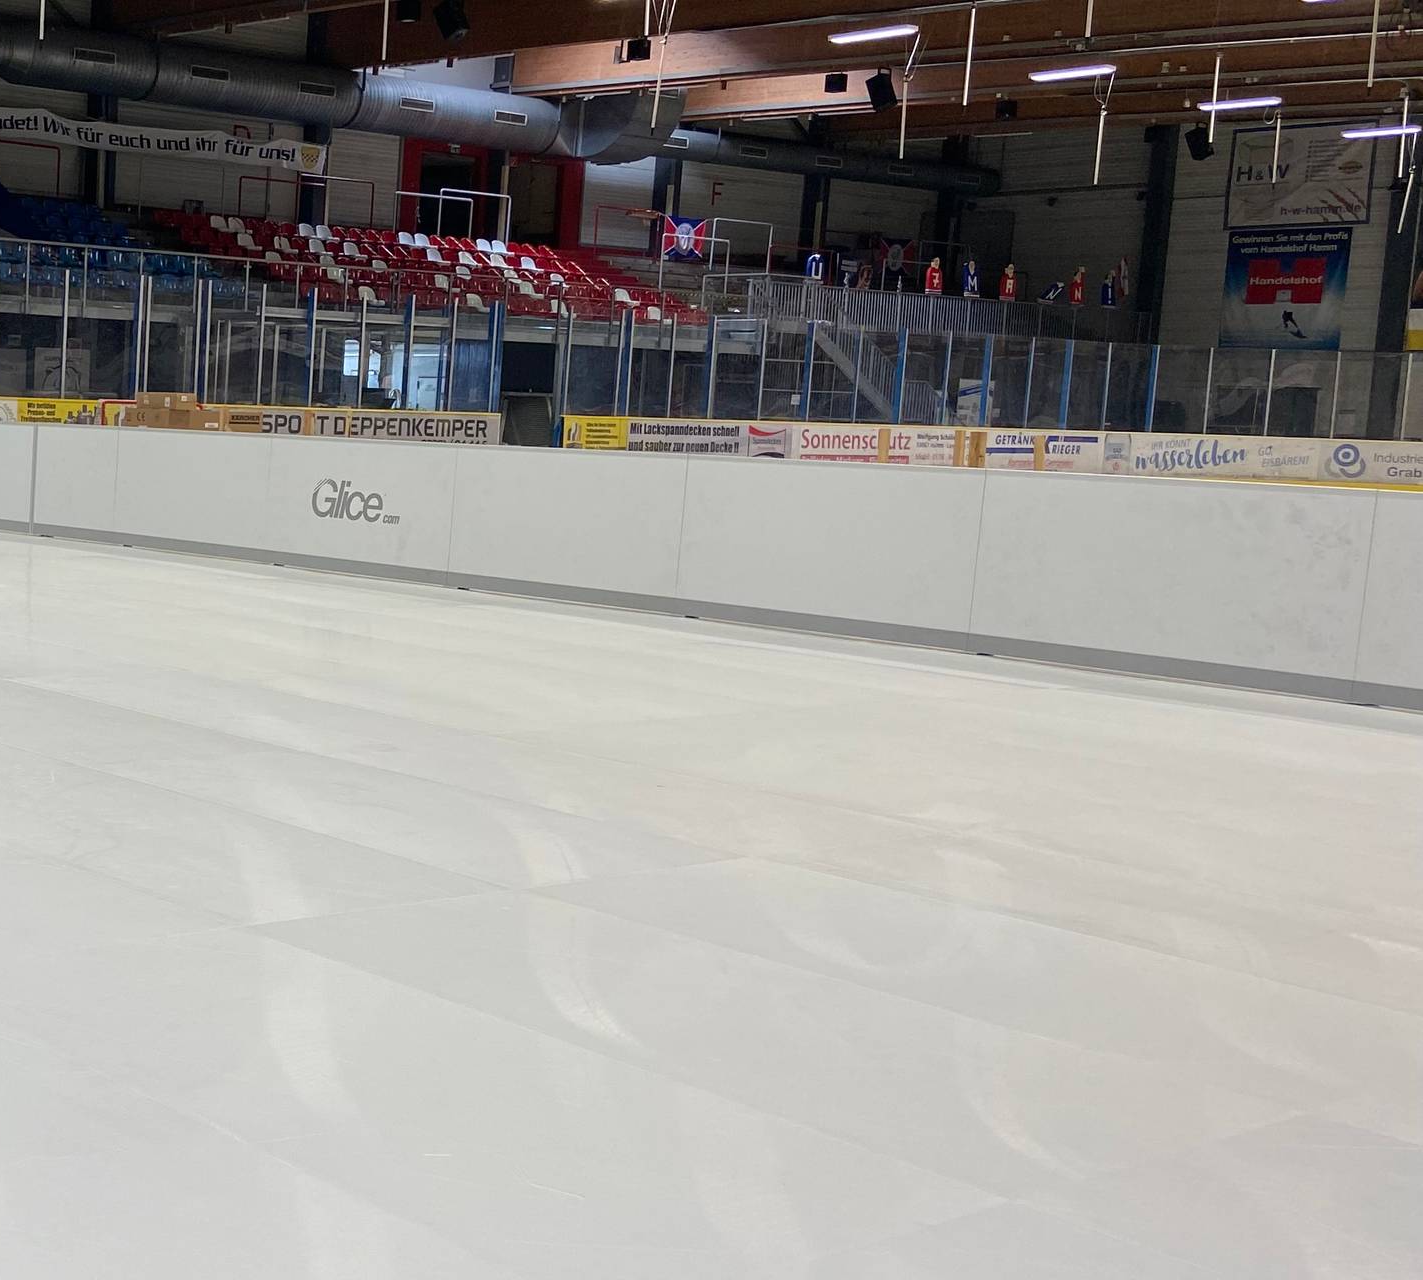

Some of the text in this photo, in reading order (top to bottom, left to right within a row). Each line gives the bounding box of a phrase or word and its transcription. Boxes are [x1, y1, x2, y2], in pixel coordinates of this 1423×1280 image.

[43, 116, 71, 137] Wir
[76, 127, 104, 144] für
[108, 134, 151, 150] euch
[155, 136, 190, 152] und
[195, 137, 218, 152] ihr
[224, 138, 251, 157] für
[258, 145, 296, 162] uns!
[710, 182, 724, 206] F
[1232, 232, 1349, 244] Gewinnen Sie mit den Profis
[1260, 244, 1307, 253] Handelshof
[1309, 244, 1338, 252] Hamm
[1249, 275, 1324, 286] Handelshof
[261, 413, 329, 434] SPOT
[630, 422, 740, 437] Mit Lackspanndecken schnell
[628, 440, 643, 451] und
[645, 440, 671, 452] sauber
[800, 428, 911, 450] Sonnenscutz
